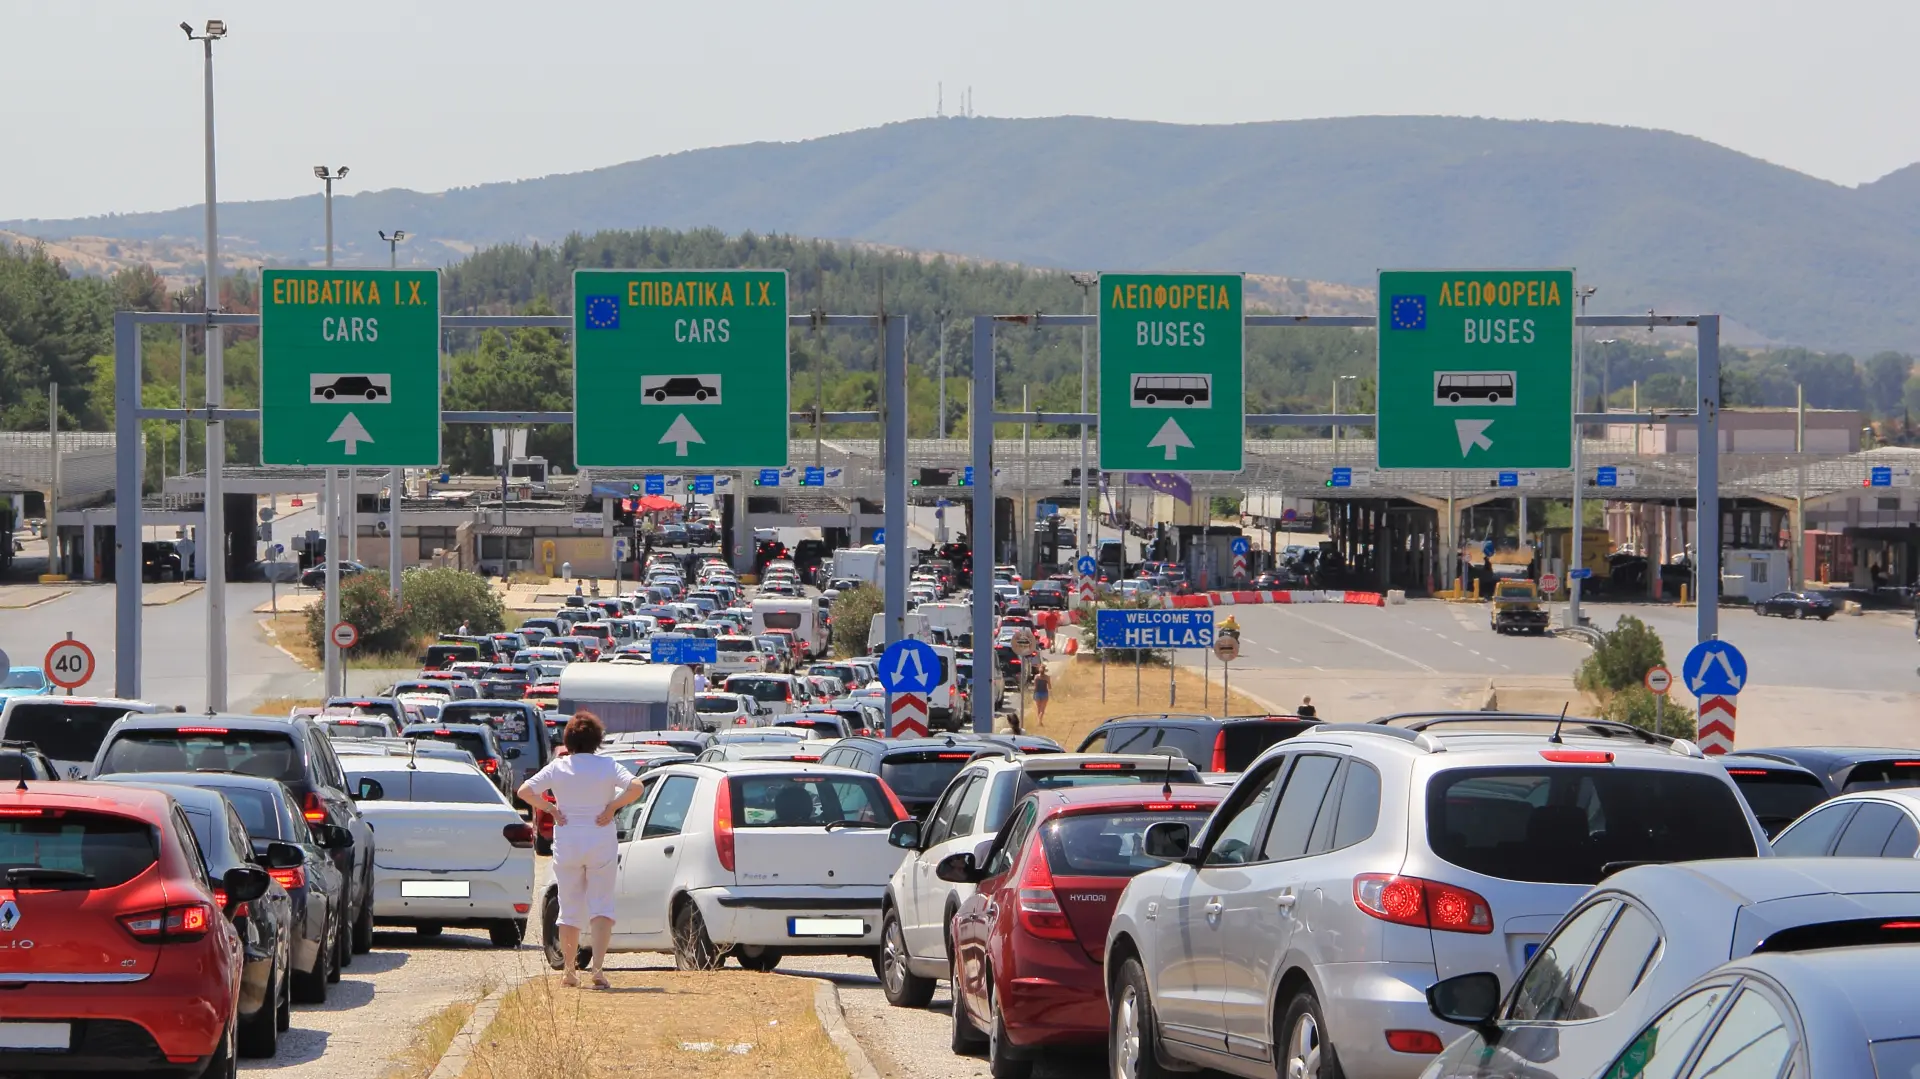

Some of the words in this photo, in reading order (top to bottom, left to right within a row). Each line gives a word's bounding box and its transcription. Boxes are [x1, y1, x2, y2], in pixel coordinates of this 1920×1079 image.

[273, 278, 381, 305] ΕΠΙΒΑΤΙΚΑ
[628, 281, 735, 307] ΕΠΙΒΑΤΙΚΑ
[322, 316, 379, 342] CARS
[674, 318, 730, 343] CARS
[1136, 321, 1205, 347] BUSES
[1464, 318, 1536, 344] BUSES
[1126, 613, 1190, 624] WELCOME
[1194, 613, 1212, 624] TO
[1125, 628, 1212, 646] HELLAS
[55, 654, 83, 673] 40
[1069, 893, 1107, 902] HYUNDAI
